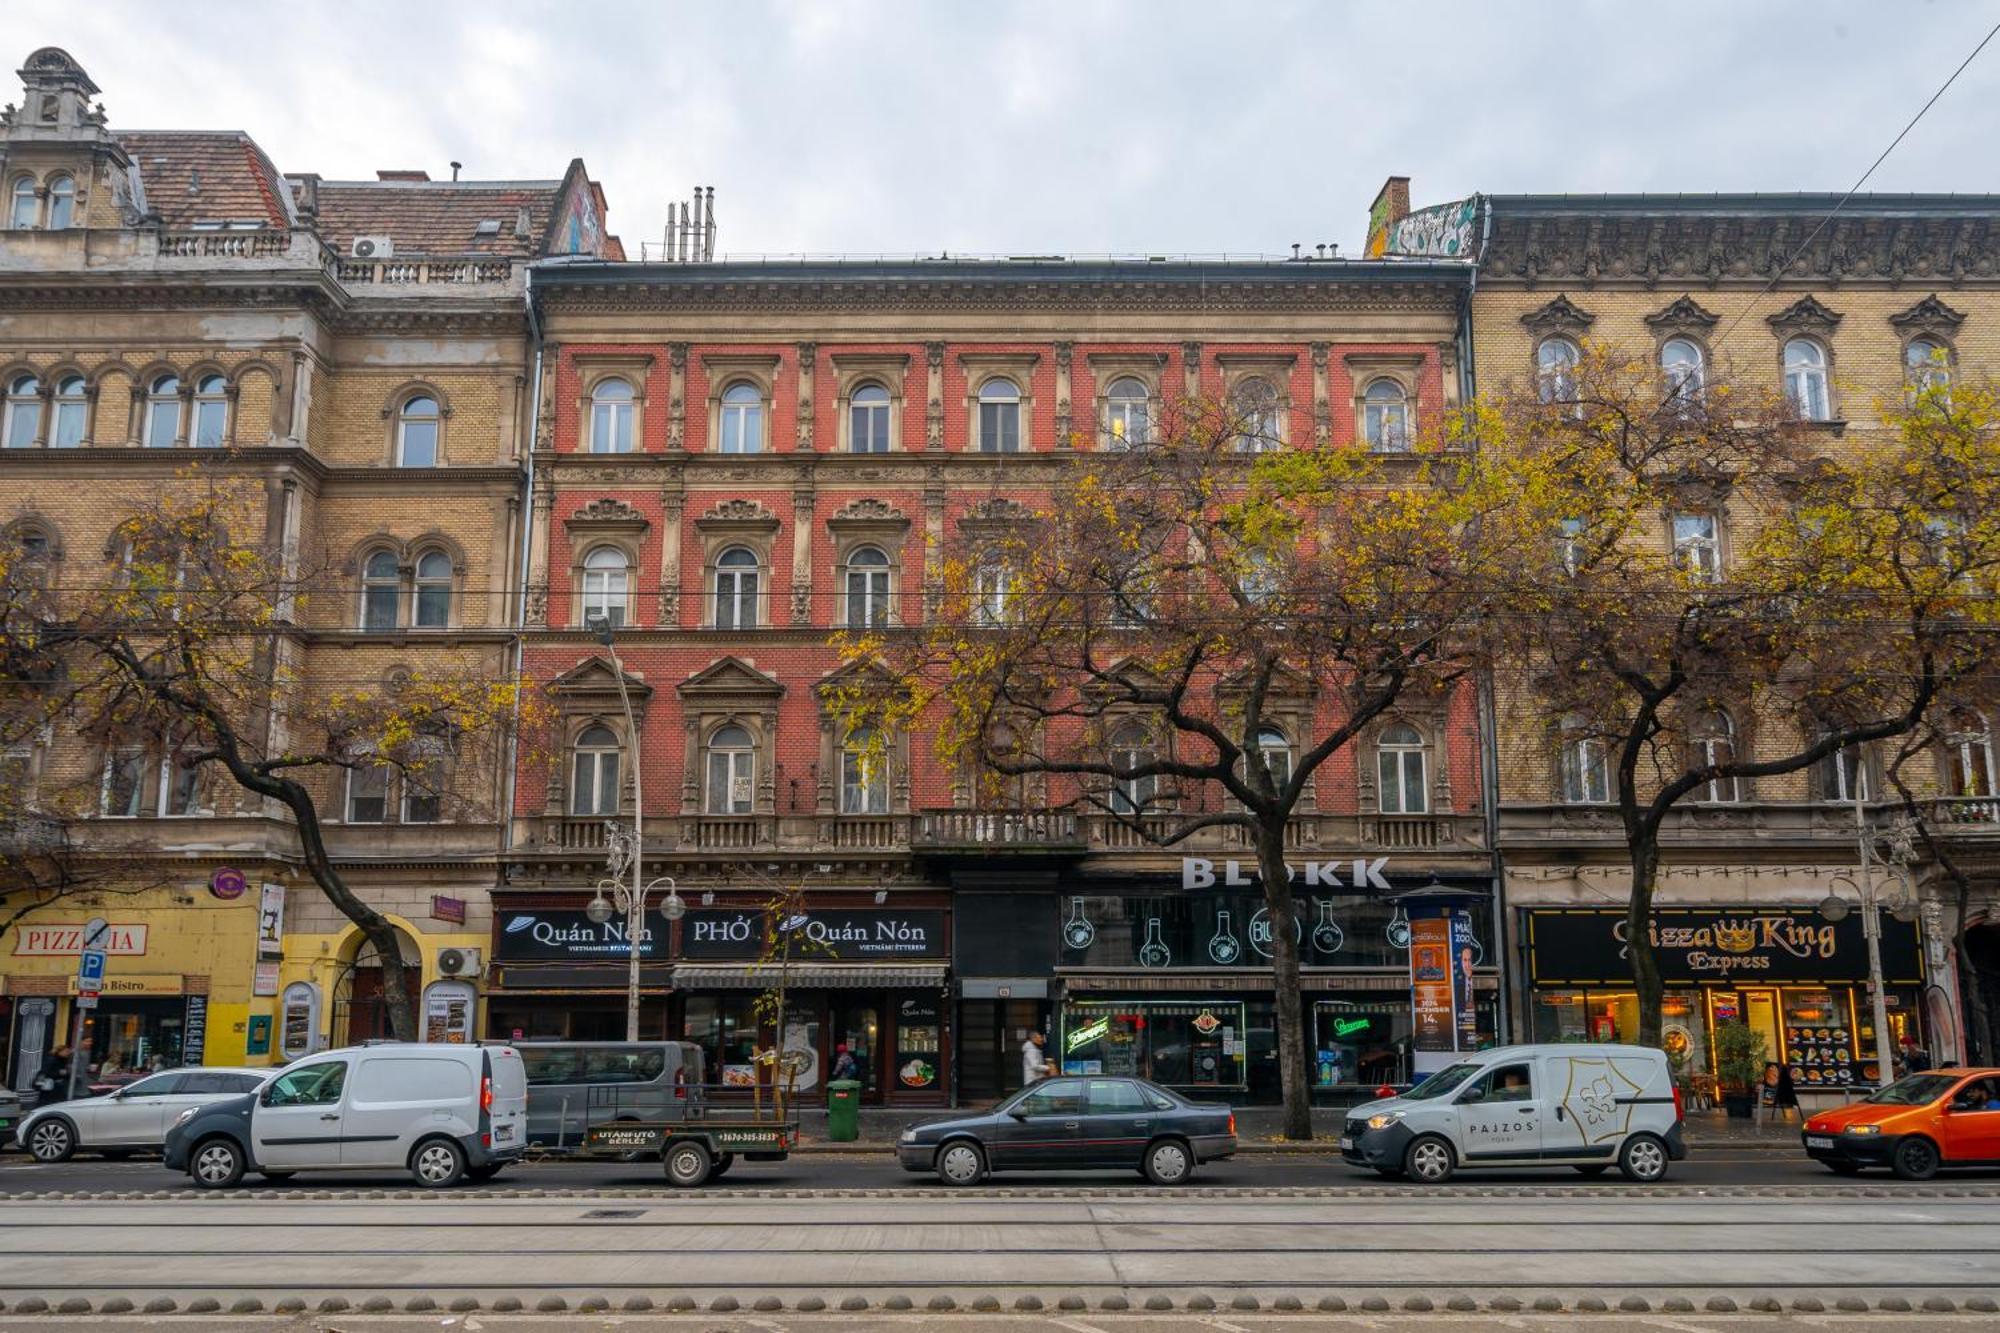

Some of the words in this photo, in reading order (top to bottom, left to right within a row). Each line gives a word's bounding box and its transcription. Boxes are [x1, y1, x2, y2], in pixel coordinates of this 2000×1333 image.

[532, 921, 595, 946] Quán
[693, 915, 751, 941] PHỞ
[806, 920, 868, 945] Quán
[875, 920, 926, 941] Nón
[1751, 917, 1837, 958] King
[27, 931, 134, 951] PIZZIA
[86, 956, 99, 976] P
[1687, 952, 1770, 976] Express
[111, 980, 144, 991] Bistro
[1422, 1014, 1438, 1023] 14.
[1469, 1122, 1534, 1134] PAJZOS
